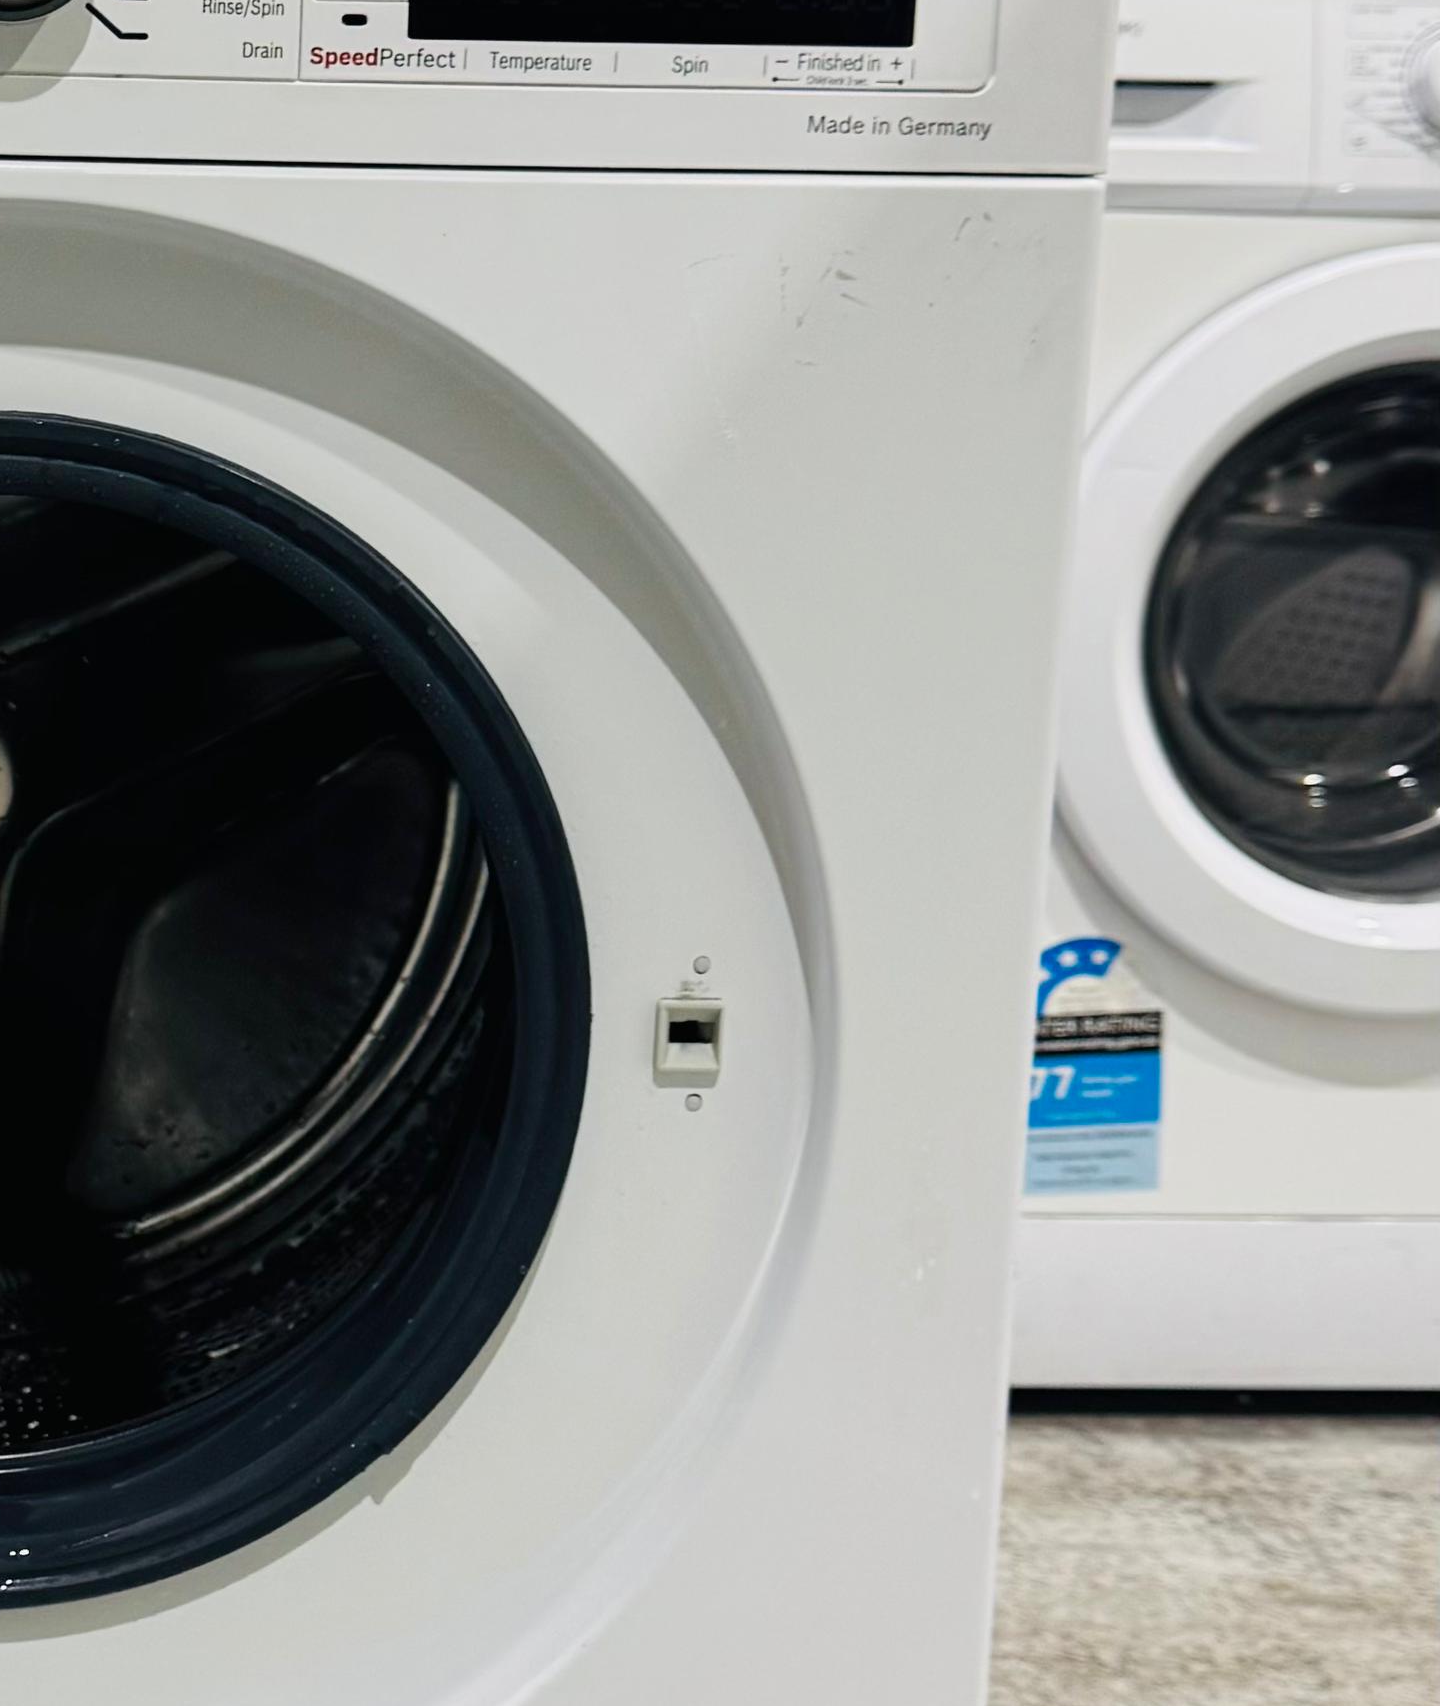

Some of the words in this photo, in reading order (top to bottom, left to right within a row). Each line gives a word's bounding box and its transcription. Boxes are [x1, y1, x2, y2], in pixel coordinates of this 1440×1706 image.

[242, 42, 283, 59] Drain
[310, 46, 456, 69] SpeedPerfect
[489, 51, 592, 73] Temperature
[672, 55, 709, 75] Spin
[797, 52, 864, 72] Finished
[867, 54, 881, 72] in
[806, 115, 865, 136] Made
[872, 115, 891, 137] in
[897, 116, 993, 141] Germany
